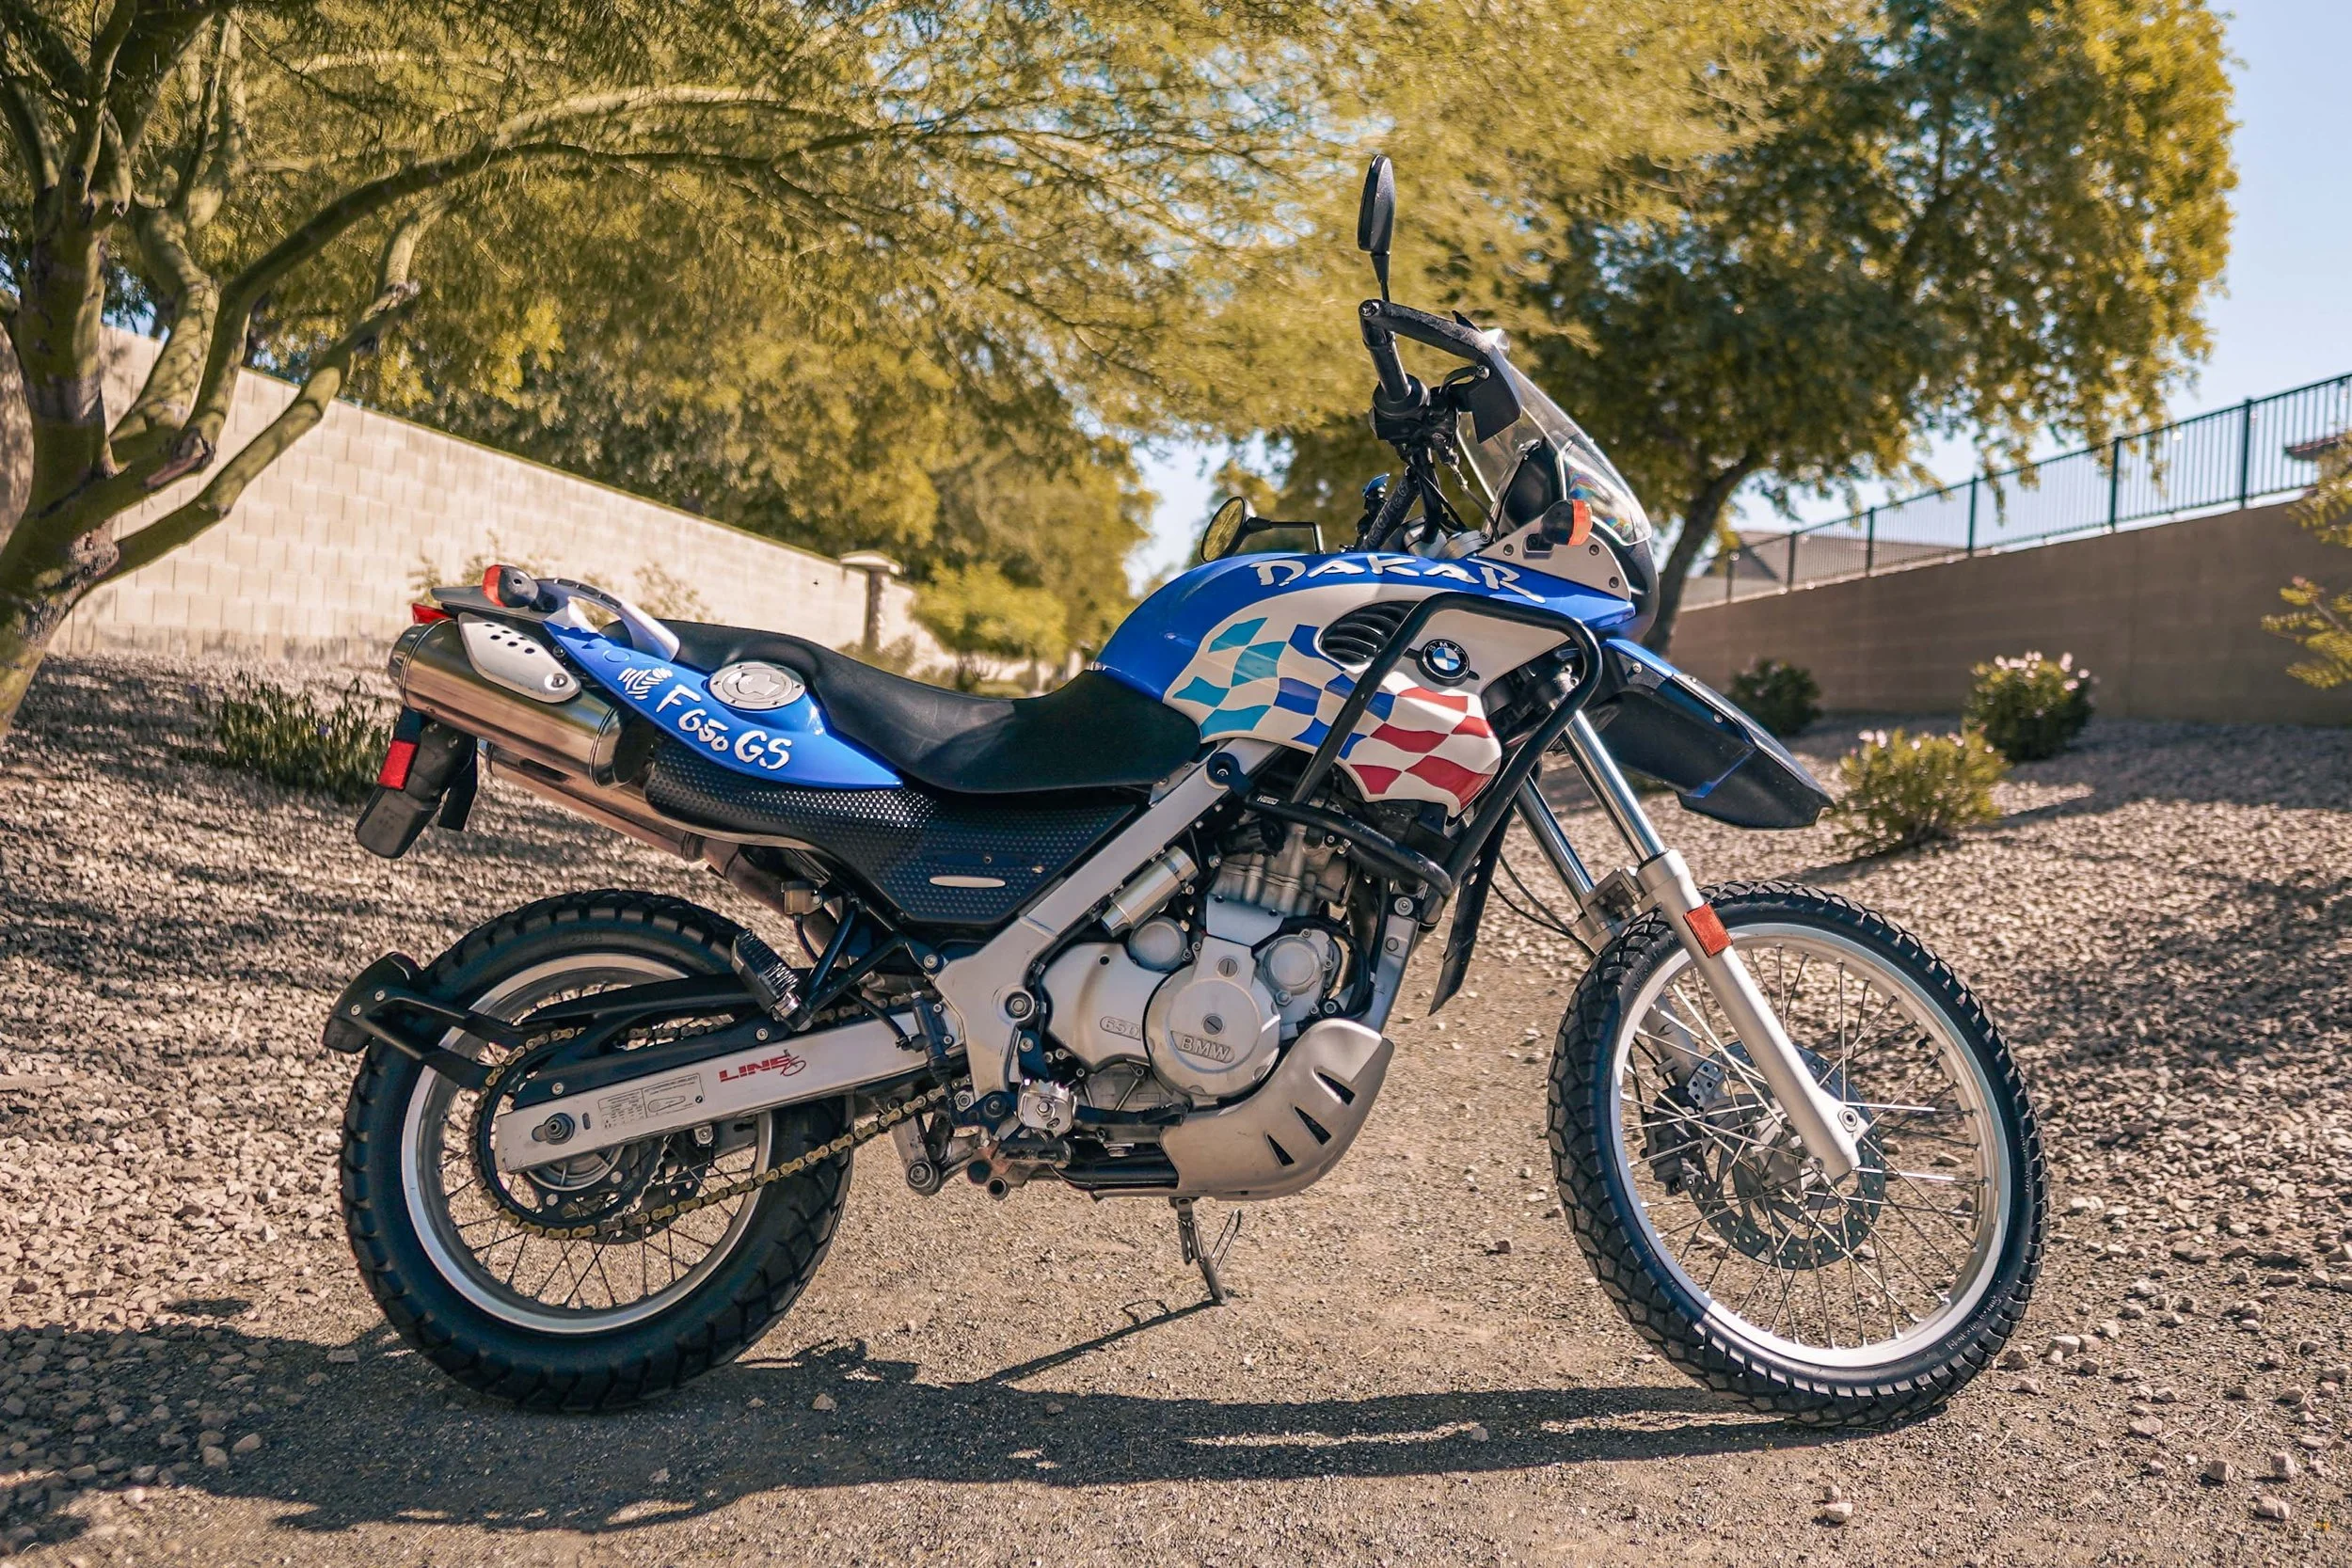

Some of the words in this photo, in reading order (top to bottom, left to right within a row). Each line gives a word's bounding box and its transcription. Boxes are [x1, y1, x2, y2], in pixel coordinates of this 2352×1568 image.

[1249, 554, 1546, 603] DAKAR
[734, 730, 792, 770] GS
[1182, 1036, 1230, 1062] BMW
